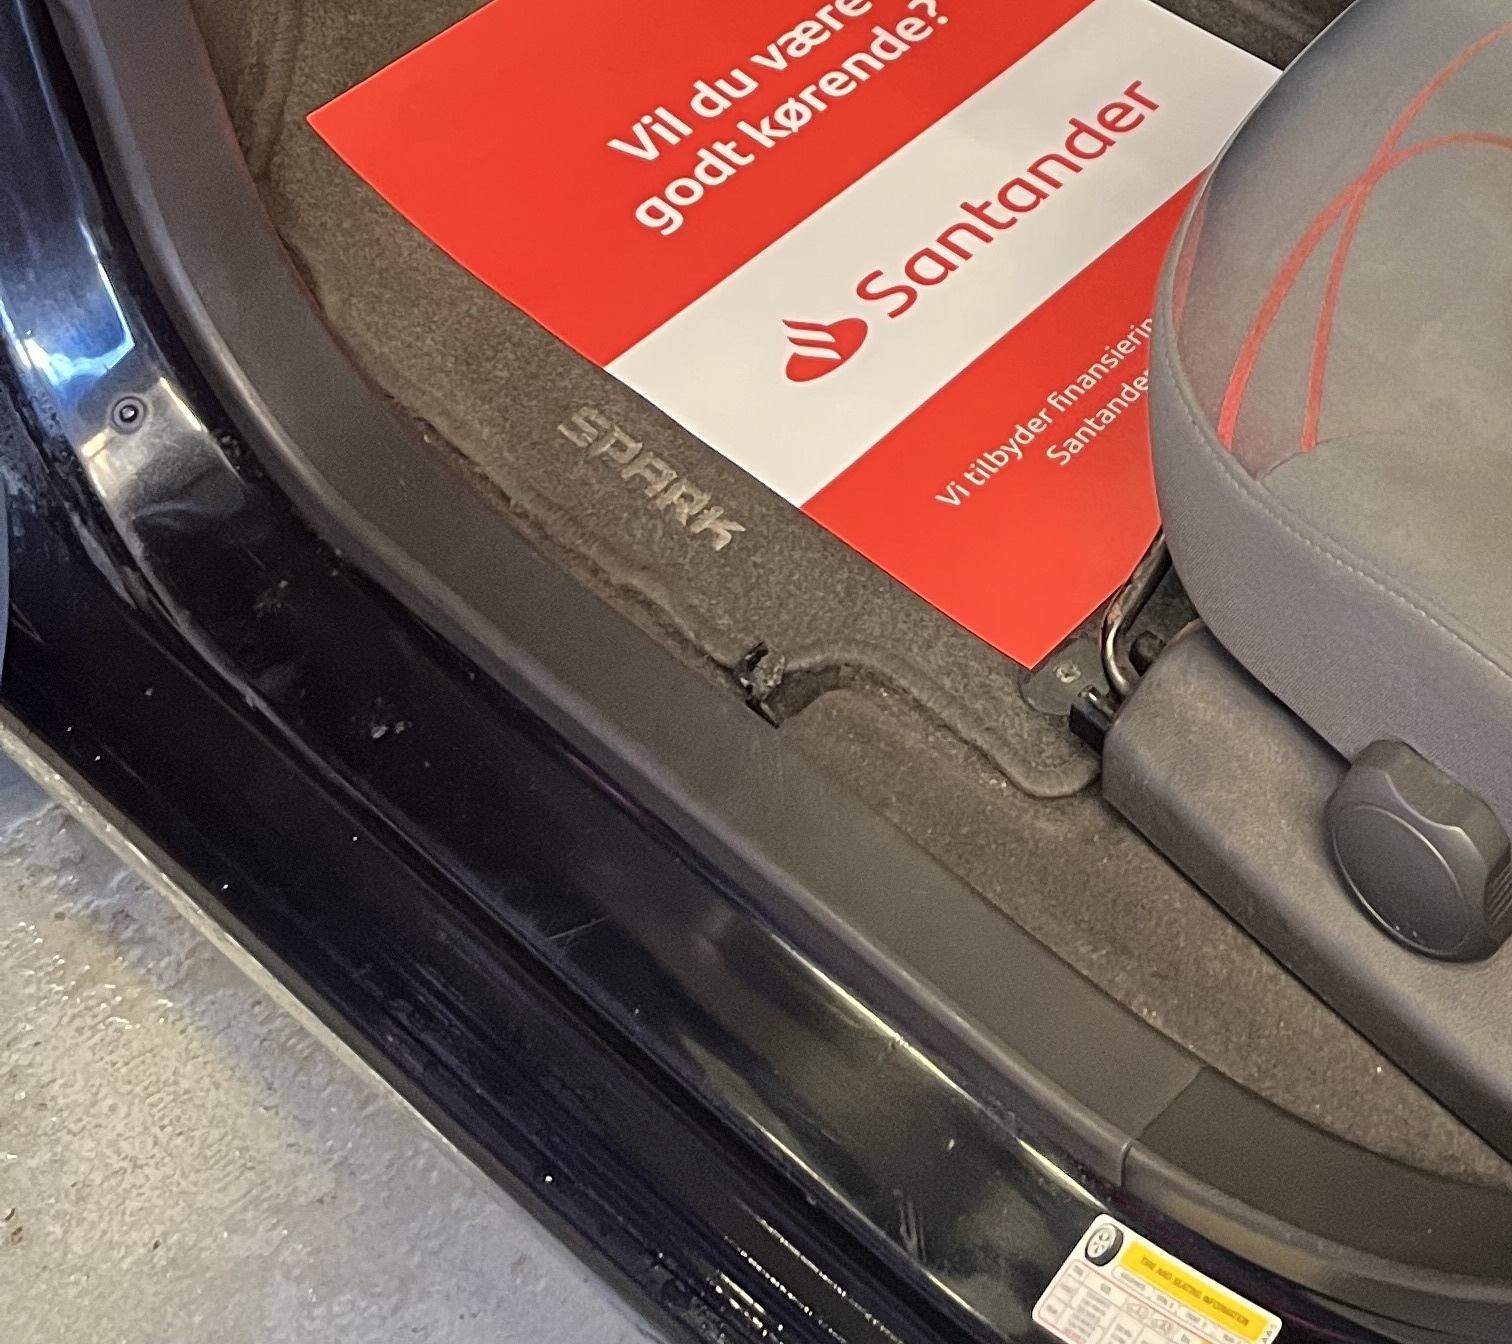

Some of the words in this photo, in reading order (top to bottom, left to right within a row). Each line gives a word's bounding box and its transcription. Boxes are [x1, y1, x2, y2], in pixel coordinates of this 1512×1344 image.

[607, 106, 693, 162] Vil
[690, 68, 759, 118] du
[635, 140, 755, 236] godt
[856, 80, 1160, 319] Santander
[934, 480, 971, 507] Vi
[963, 408, 1054, 487] tilbyder
[1046, 317, 1153, 412] finansierin
[1045, 369, 1149, 467] Santande
[557, 406, 747, 551] SPARK
